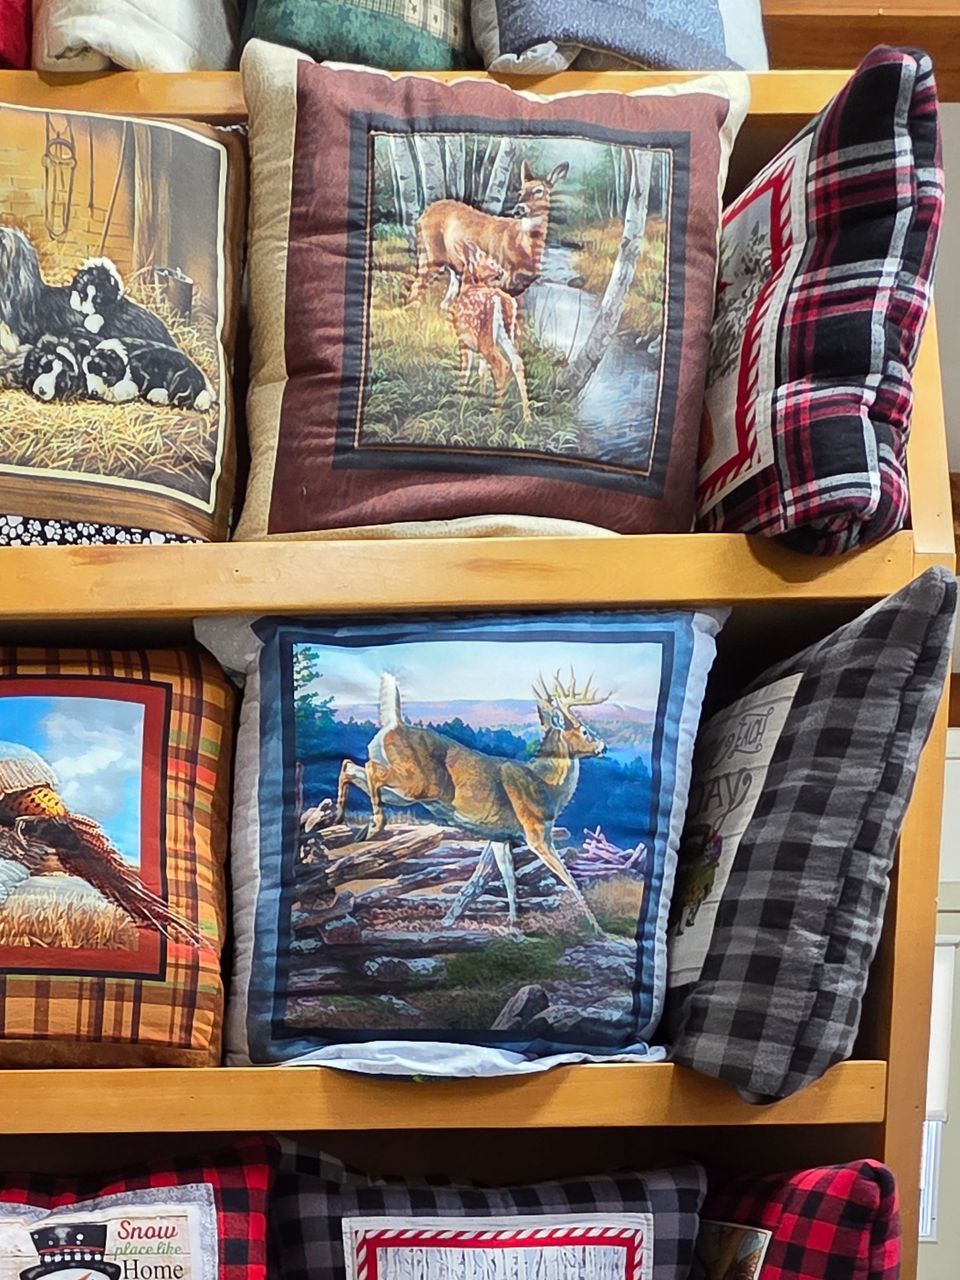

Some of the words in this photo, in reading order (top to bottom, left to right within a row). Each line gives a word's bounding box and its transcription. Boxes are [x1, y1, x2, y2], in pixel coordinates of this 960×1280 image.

[732, 708, 774, 757] EACH
[117, 1220, 179, 1240] Snow
[114, 1241, 154, 1261] place
[156, 1241, 183, 1255] like
[122, 1259, 185, 1280] Home
